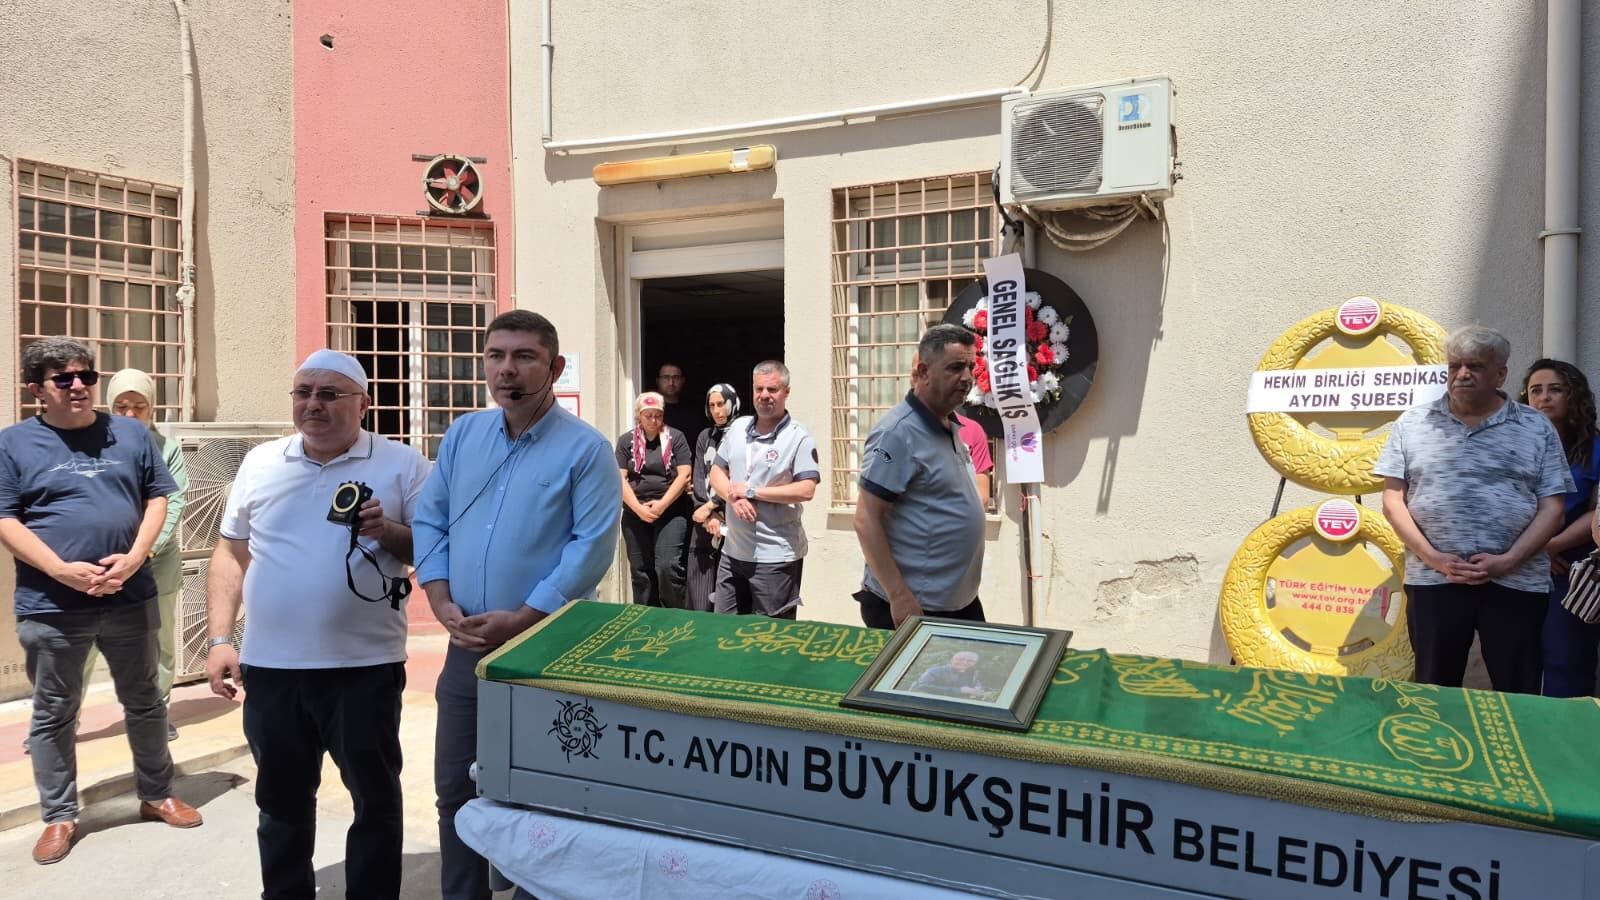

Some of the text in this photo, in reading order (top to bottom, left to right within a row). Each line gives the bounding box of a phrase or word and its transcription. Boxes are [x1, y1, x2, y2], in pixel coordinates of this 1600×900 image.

[1340, 315, 1375, 325] TEV
[992, 280, 1032, 420] GENEL SAĞLIK İŞ
[1263, 368, 1448, 389] HEKİM BİRLİĞİ SENDİKAS
[1288, 388, 1414, 409] AYDIN ŞUBESİ
[1321, 519, 1354, 529] TEV
[1279, 580, 1306, 589] TÜRK
[1310, 583, 1346, 592] EĞİTİM
[1301, 602, 1321, 610] 444
[617, 724, 1500, 900] T.C. AYDIN BÜYÜKŞEHİR BELEDİYESİ
